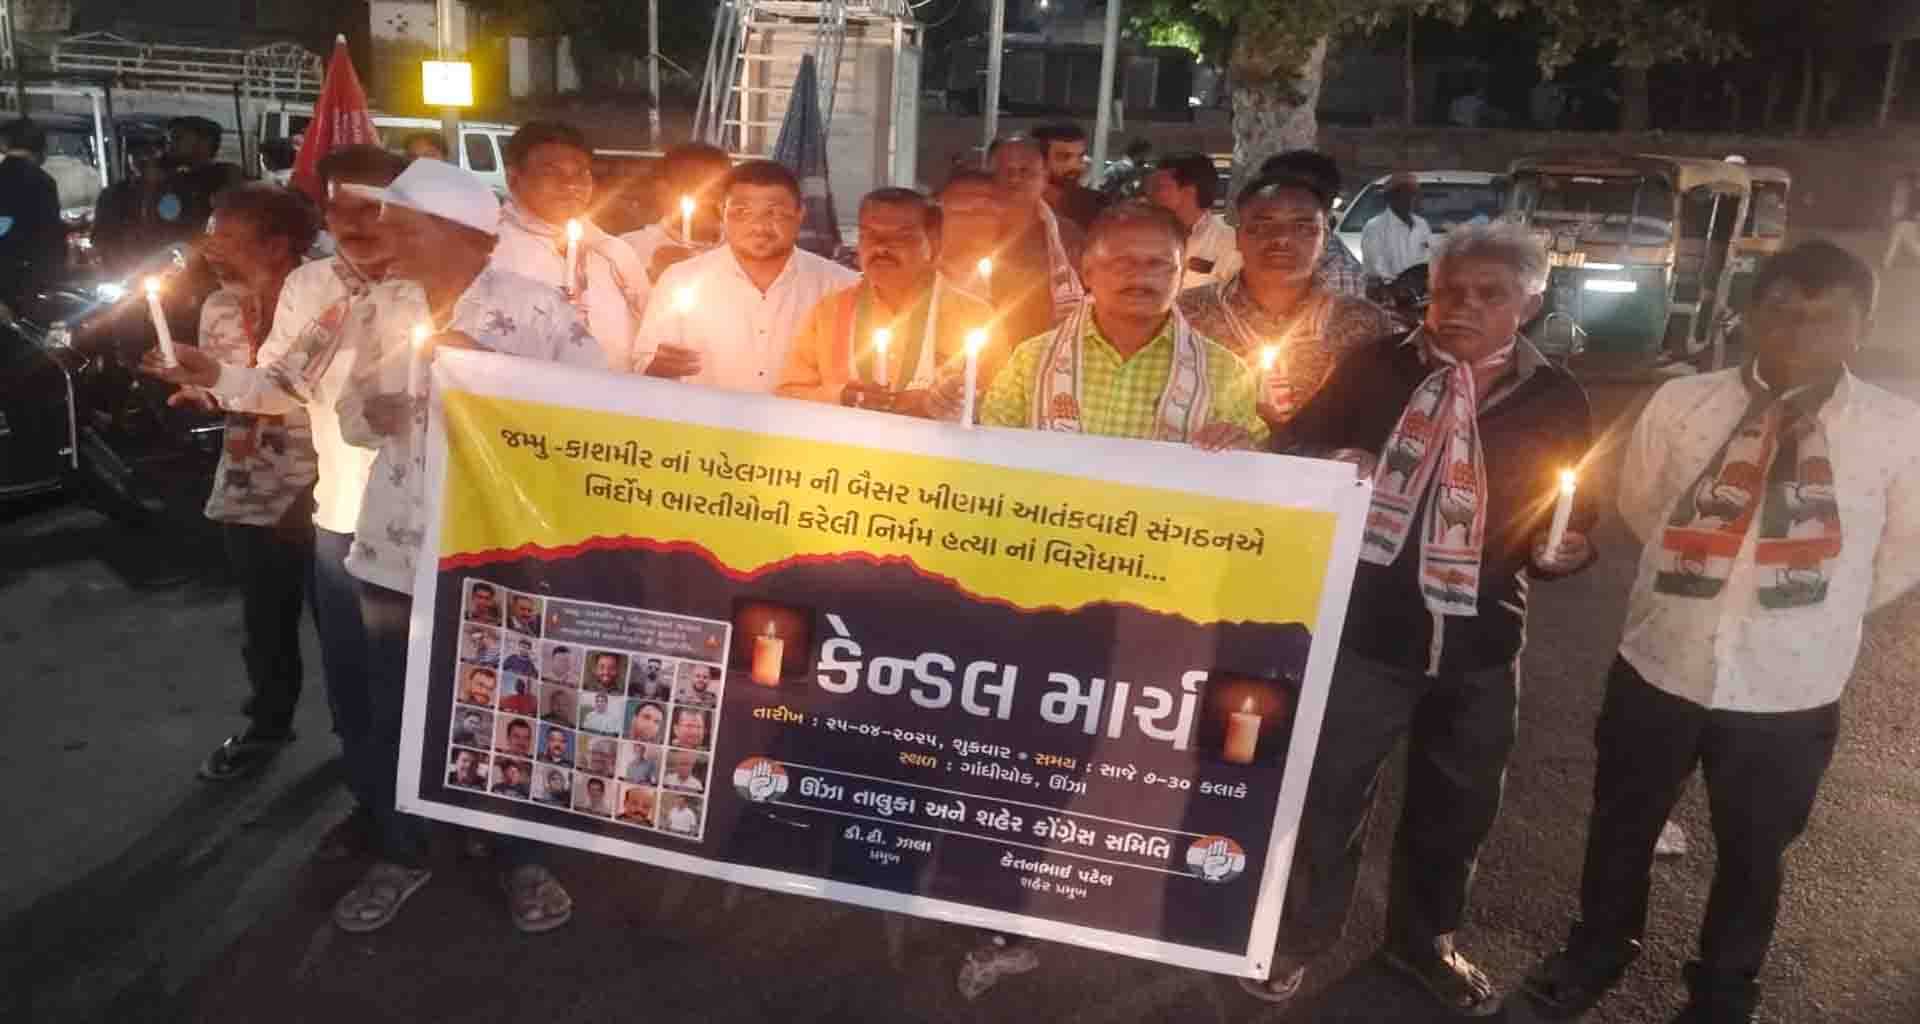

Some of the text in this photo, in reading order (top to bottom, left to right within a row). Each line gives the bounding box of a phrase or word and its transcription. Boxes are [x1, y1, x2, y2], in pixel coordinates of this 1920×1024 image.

[501, 429, 549, 459] જમ્મુ
[661, 450, 691, 473] નાં
[699, 452, 801, 488] પહેલગામ
[809, 467, 840, 495] ની
[847, 470, 911, 505] બૈસર
[919, 483, 1003, 519] ખીણમાં
[1012, 501, 1138, 538] આતંકવાદી
[1146, 518, 1265, 556] સંગઠનએ
[586, 473, 653, 507] નિર્દોષ
[661, 491, 790, 528] ભારતીયોની
[798, 505, 859, 537] કરેલી
[867, 513, 934, 547] નિર્મમ
[941, 531, 997, 557] હત્યા
[1006, 538, 1036, 563] નાં
[816, 614, 1019, 721] કેન્ડલ
[1039, 670, 1209, 751] માર્ચ
[752, 705, 804, 724] તારીખ
[1033, 752, 1077, 770] સમય
[1099, 763, 1138, 782] સાજે
[1199, 779, 1250, 800] કલાકે
[1048, 772, 1088, 796] ઊંઝા
[799, 777, 1171, 860] ઊંઝા તાલુકા અને શહેર કોંગ્રેસ સમિતિ
[894, 836, 933, 853] ઝાલા
[1077, 868, 1114, 887] પટેલ
